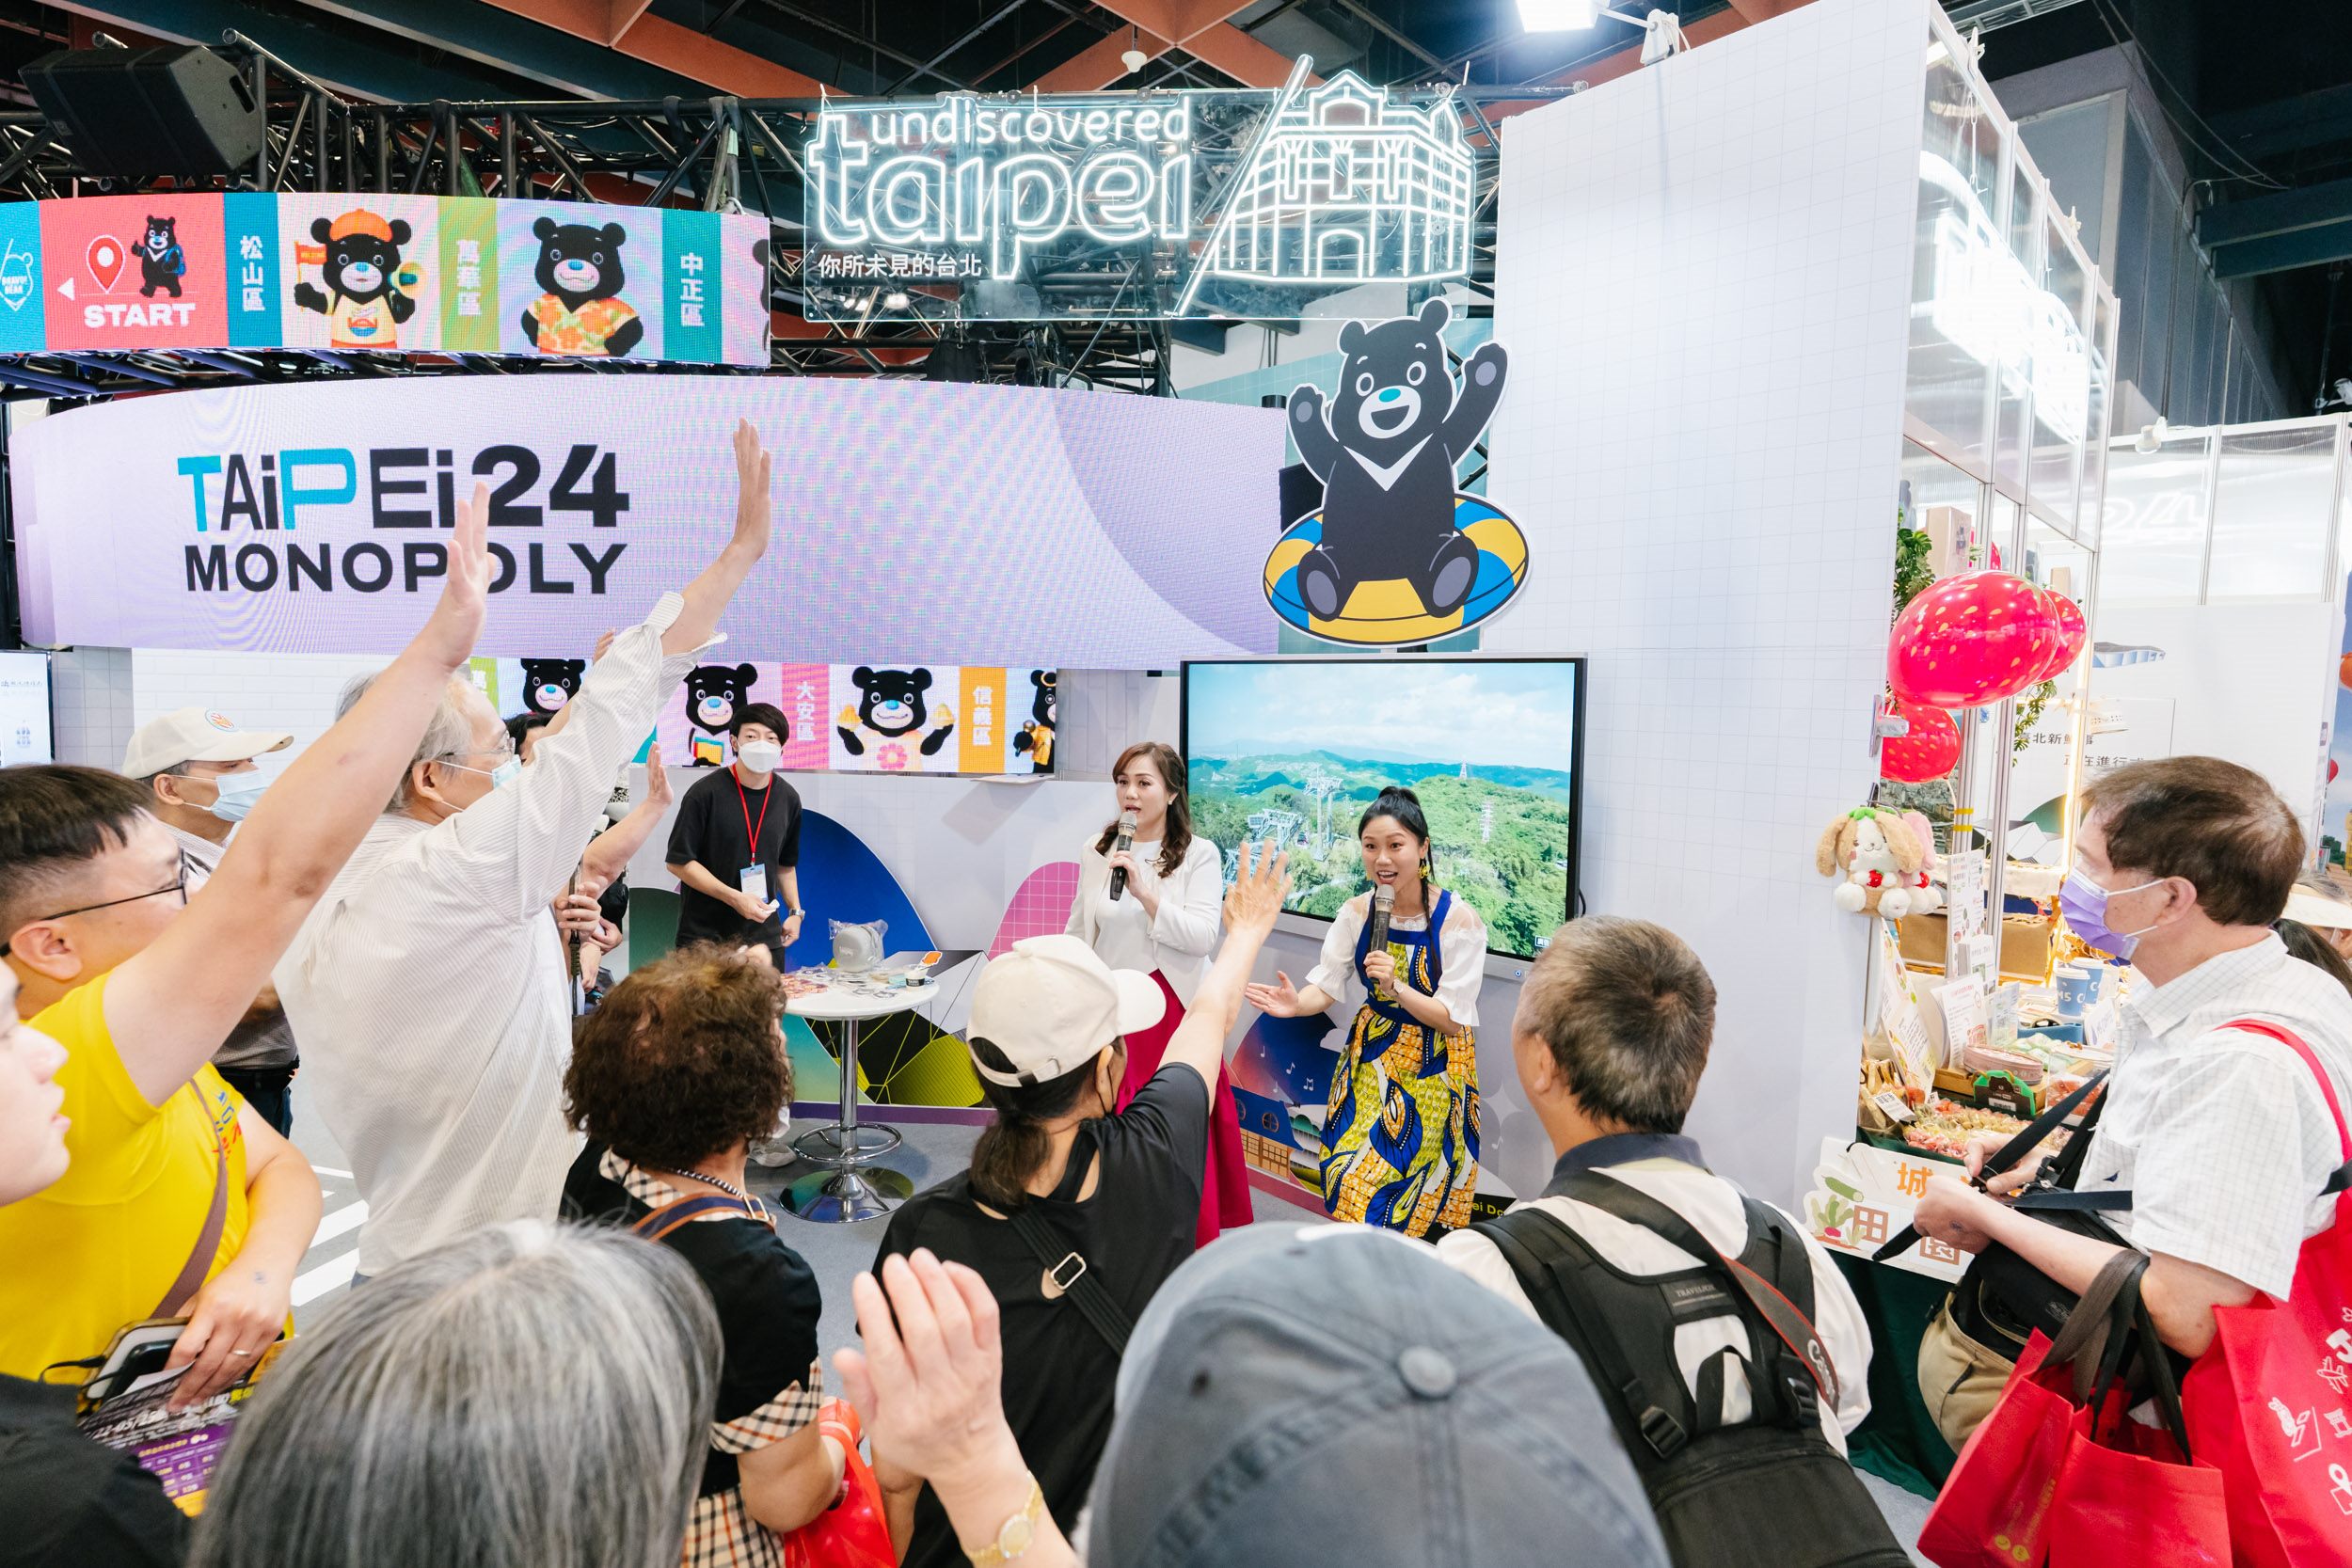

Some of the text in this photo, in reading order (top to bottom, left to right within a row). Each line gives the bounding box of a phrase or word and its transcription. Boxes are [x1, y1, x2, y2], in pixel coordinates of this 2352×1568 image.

[871, 95, 1190, 145] undiscovered
[808, 113, 1191, 280] taipei
[240, 235, 265, 311] 松山區
[680, 252, 705, 326] 中正區
[818, 254, 982, 277] 你所未見的台北
[84, 303, 197, 328] START
[796, 680, 816, 741] 大安區
